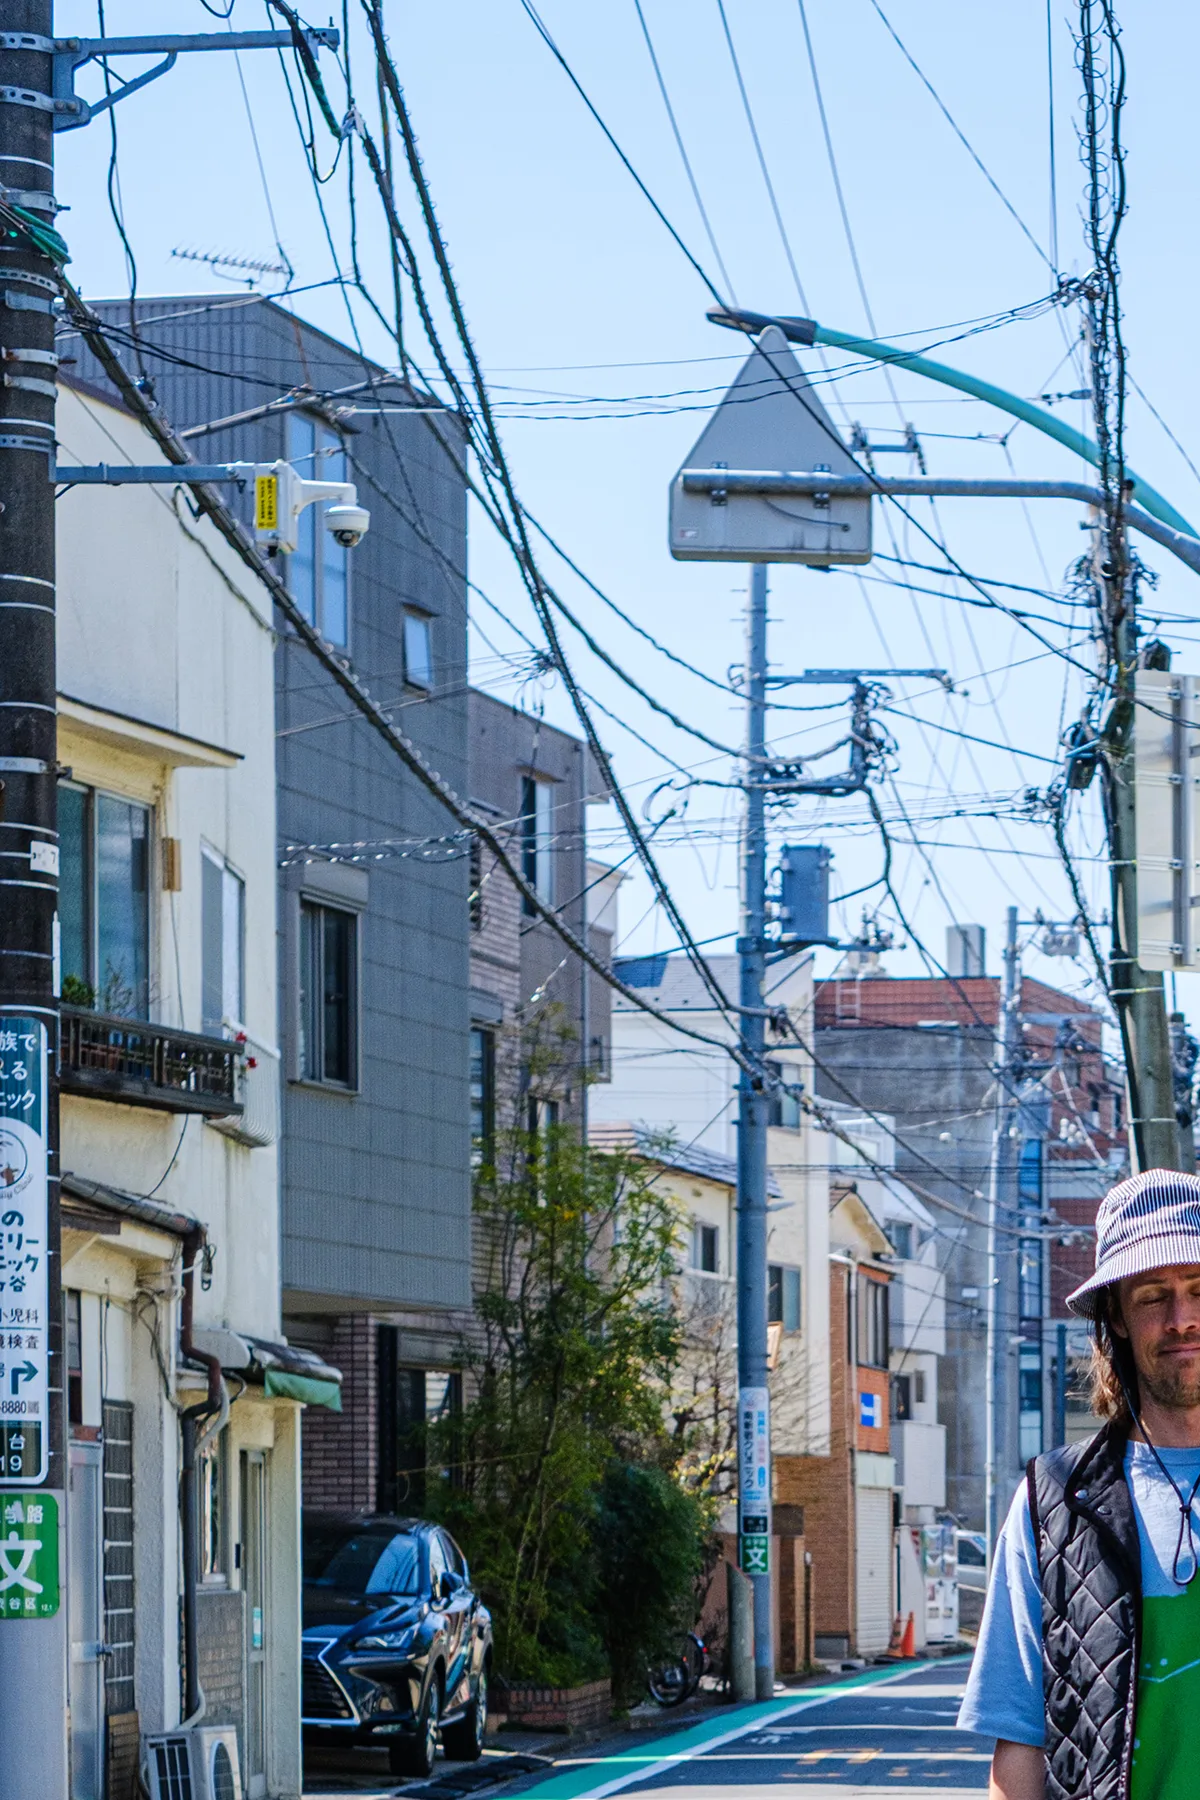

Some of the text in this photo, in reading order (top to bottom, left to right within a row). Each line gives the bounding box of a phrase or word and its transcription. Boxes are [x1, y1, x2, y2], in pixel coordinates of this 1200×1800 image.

[1, 1210, 24, 1227] の
[0, 1232, 39, 1251] リー
[0, 1531, 43, 1594] 文
[745, 1546, 766, 1567] 文
